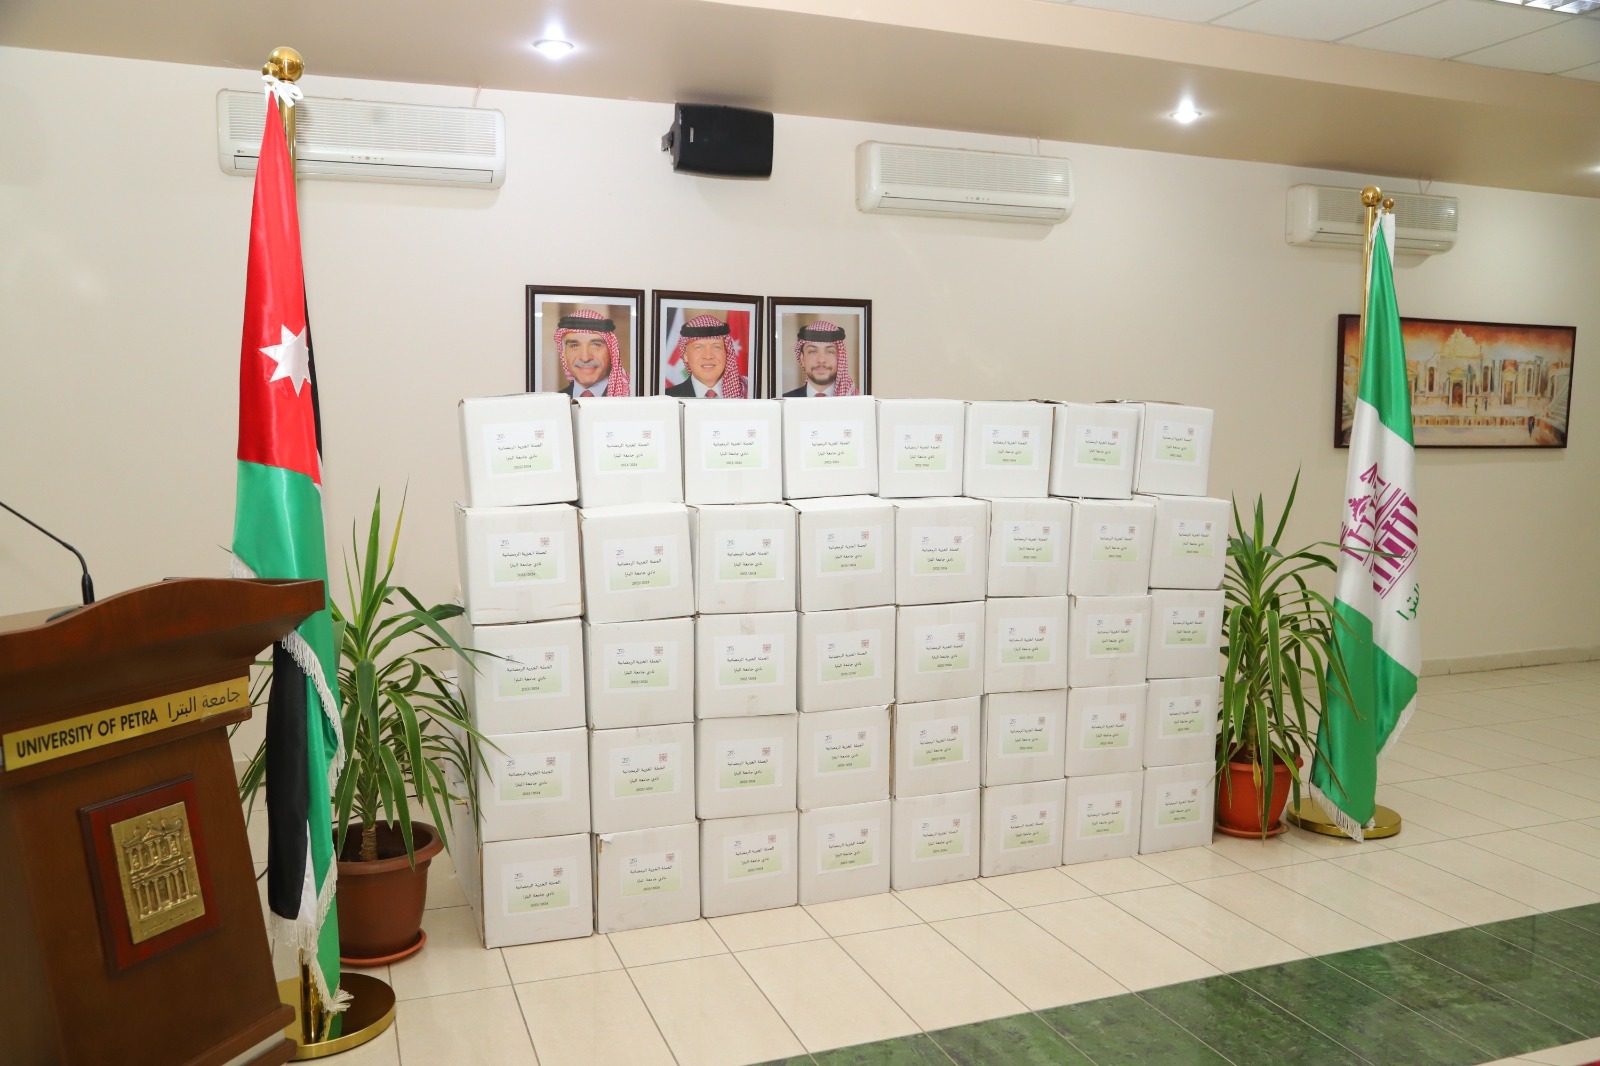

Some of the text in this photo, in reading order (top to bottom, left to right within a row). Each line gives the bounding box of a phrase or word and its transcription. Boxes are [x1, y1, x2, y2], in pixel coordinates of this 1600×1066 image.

[167, 687, 241, 723] جامعة البترا
[16, 708, 158, 759] UNIVERSITY OF PETRA
